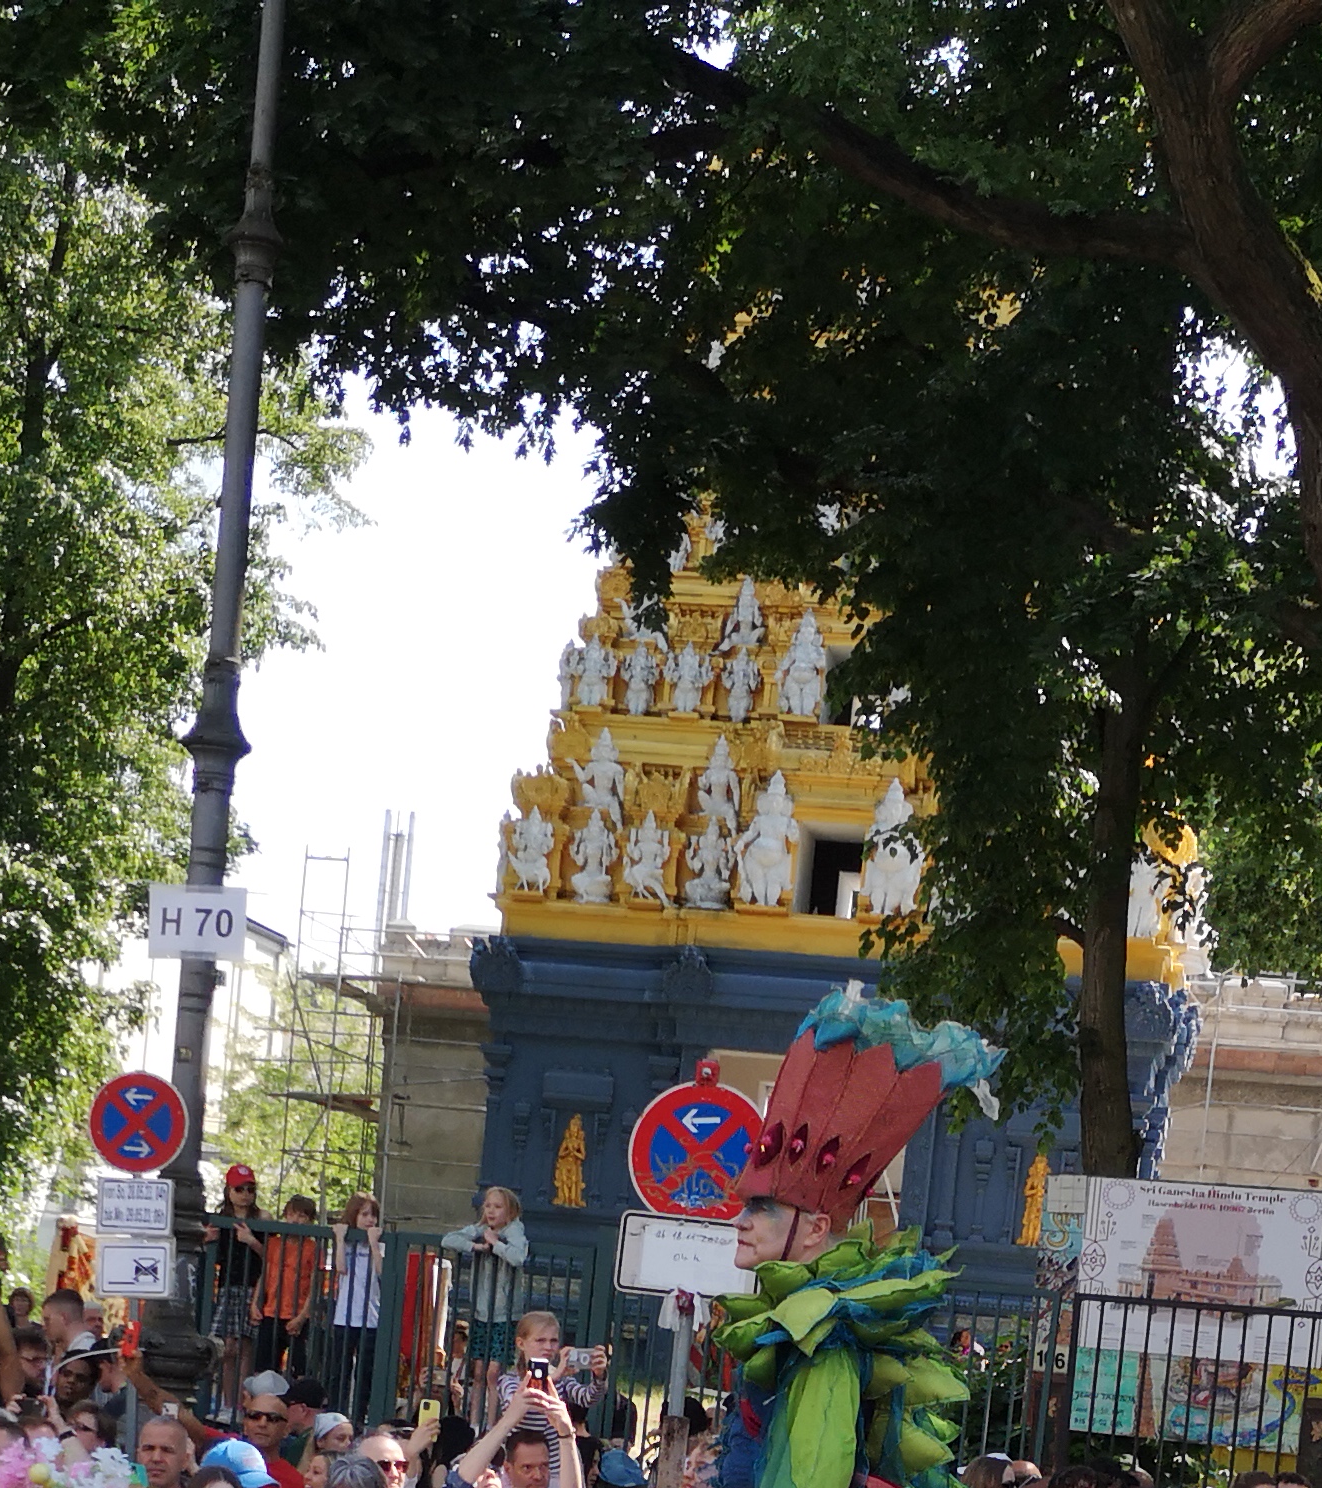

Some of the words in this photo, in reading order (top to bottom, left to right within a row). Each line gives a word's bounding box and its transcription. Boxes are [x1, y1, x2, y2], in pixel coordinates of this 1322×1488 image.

[161, 907, 182, 935] H
[195, 907, 233, 937] 70
[1139, 1185, 1156, 1195] Sri
[1158, 1186, 1205, 1198] Ganesha
[1208, 1189, 1242, 1200] Hindu
[1245, 1192, 1287, 1205] Temple
[1247, 1206, 1275, 1215] Berlin
[1037, 1350, 1066, 1370] 16
